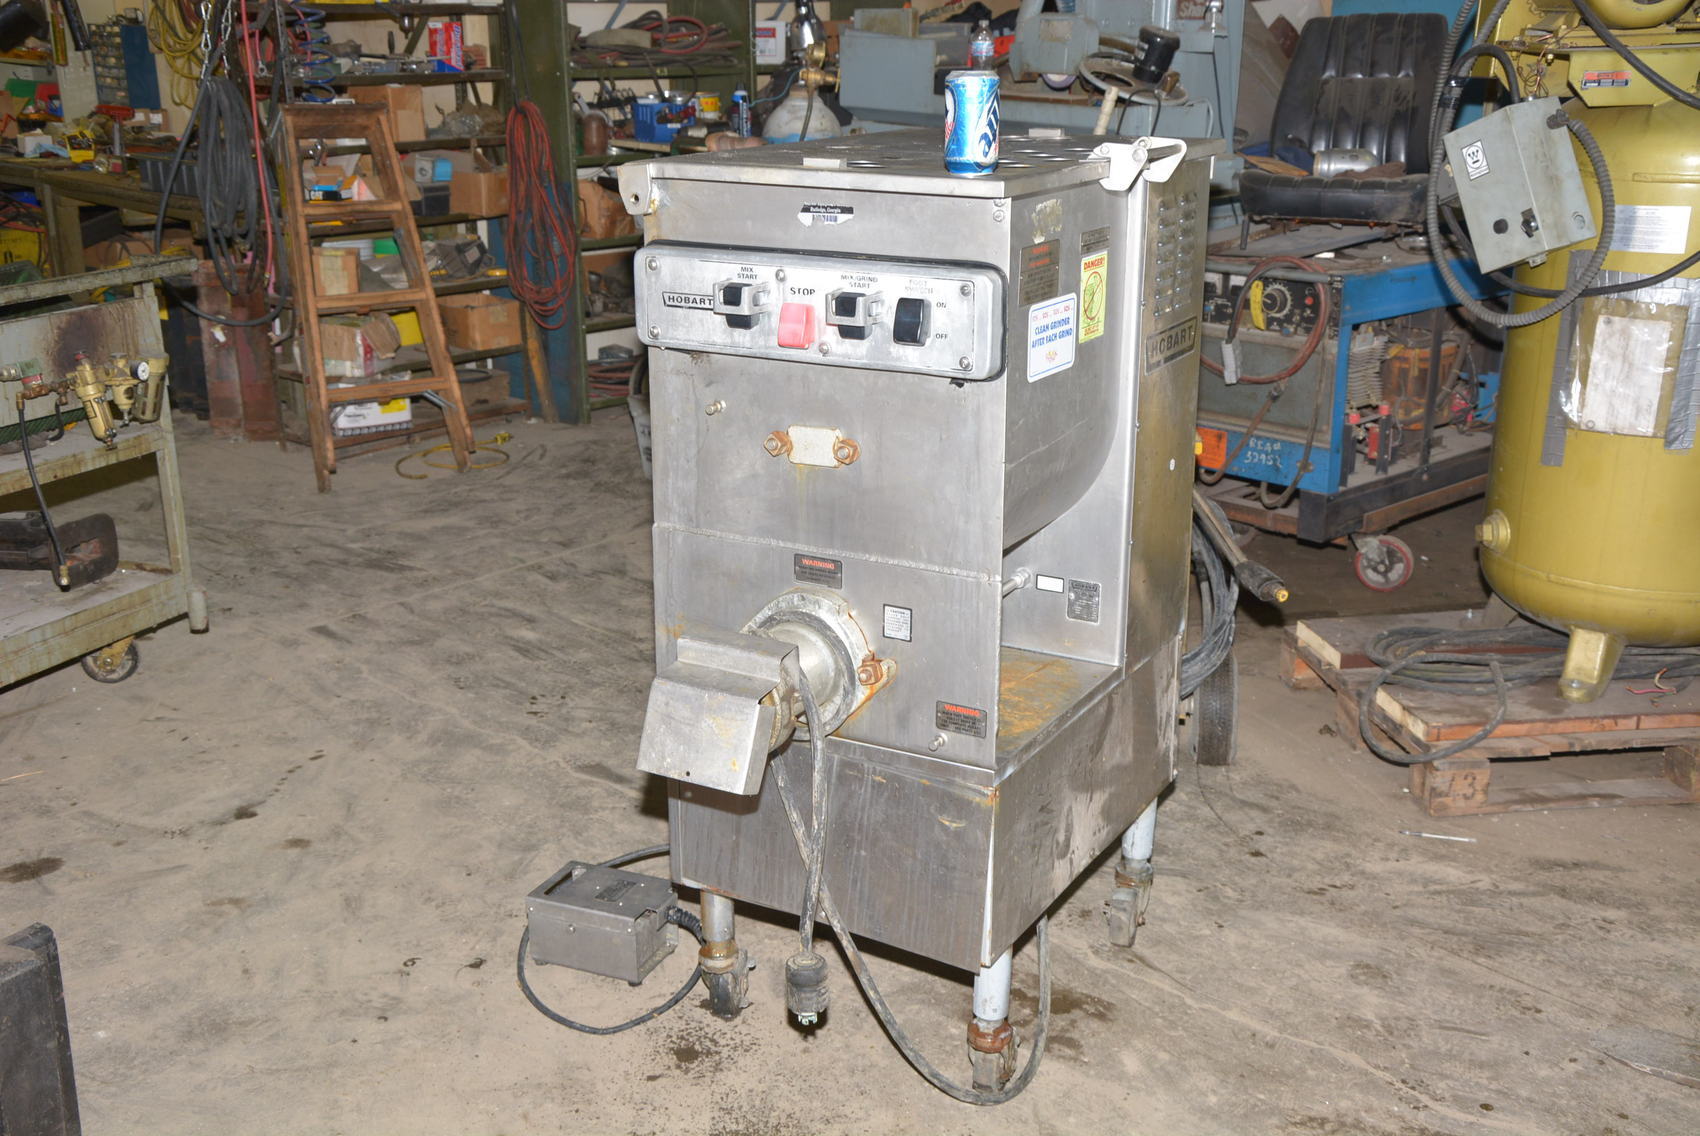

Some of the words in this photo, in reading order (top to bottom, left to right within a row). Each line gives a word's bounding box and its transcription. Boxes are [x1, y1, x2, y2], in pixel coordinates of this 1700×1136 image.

[790, 287, 816, 296] STOP
[667, 295, 714, 306] HOBART
[1034, 323, 1050, 336] CLEAN
[1050, 316, 1070, 330] GRINDER
[1031, 337, 1046, 348] AFTER
[1046, 332, 1058, 345] EACH
[1058, 328, 1073, 340] GRIND
[1151, 325, 1193, 359] HOBART
[801, 558, 836, 569] WARNING
[944, 703, 981, 717] WARNING
